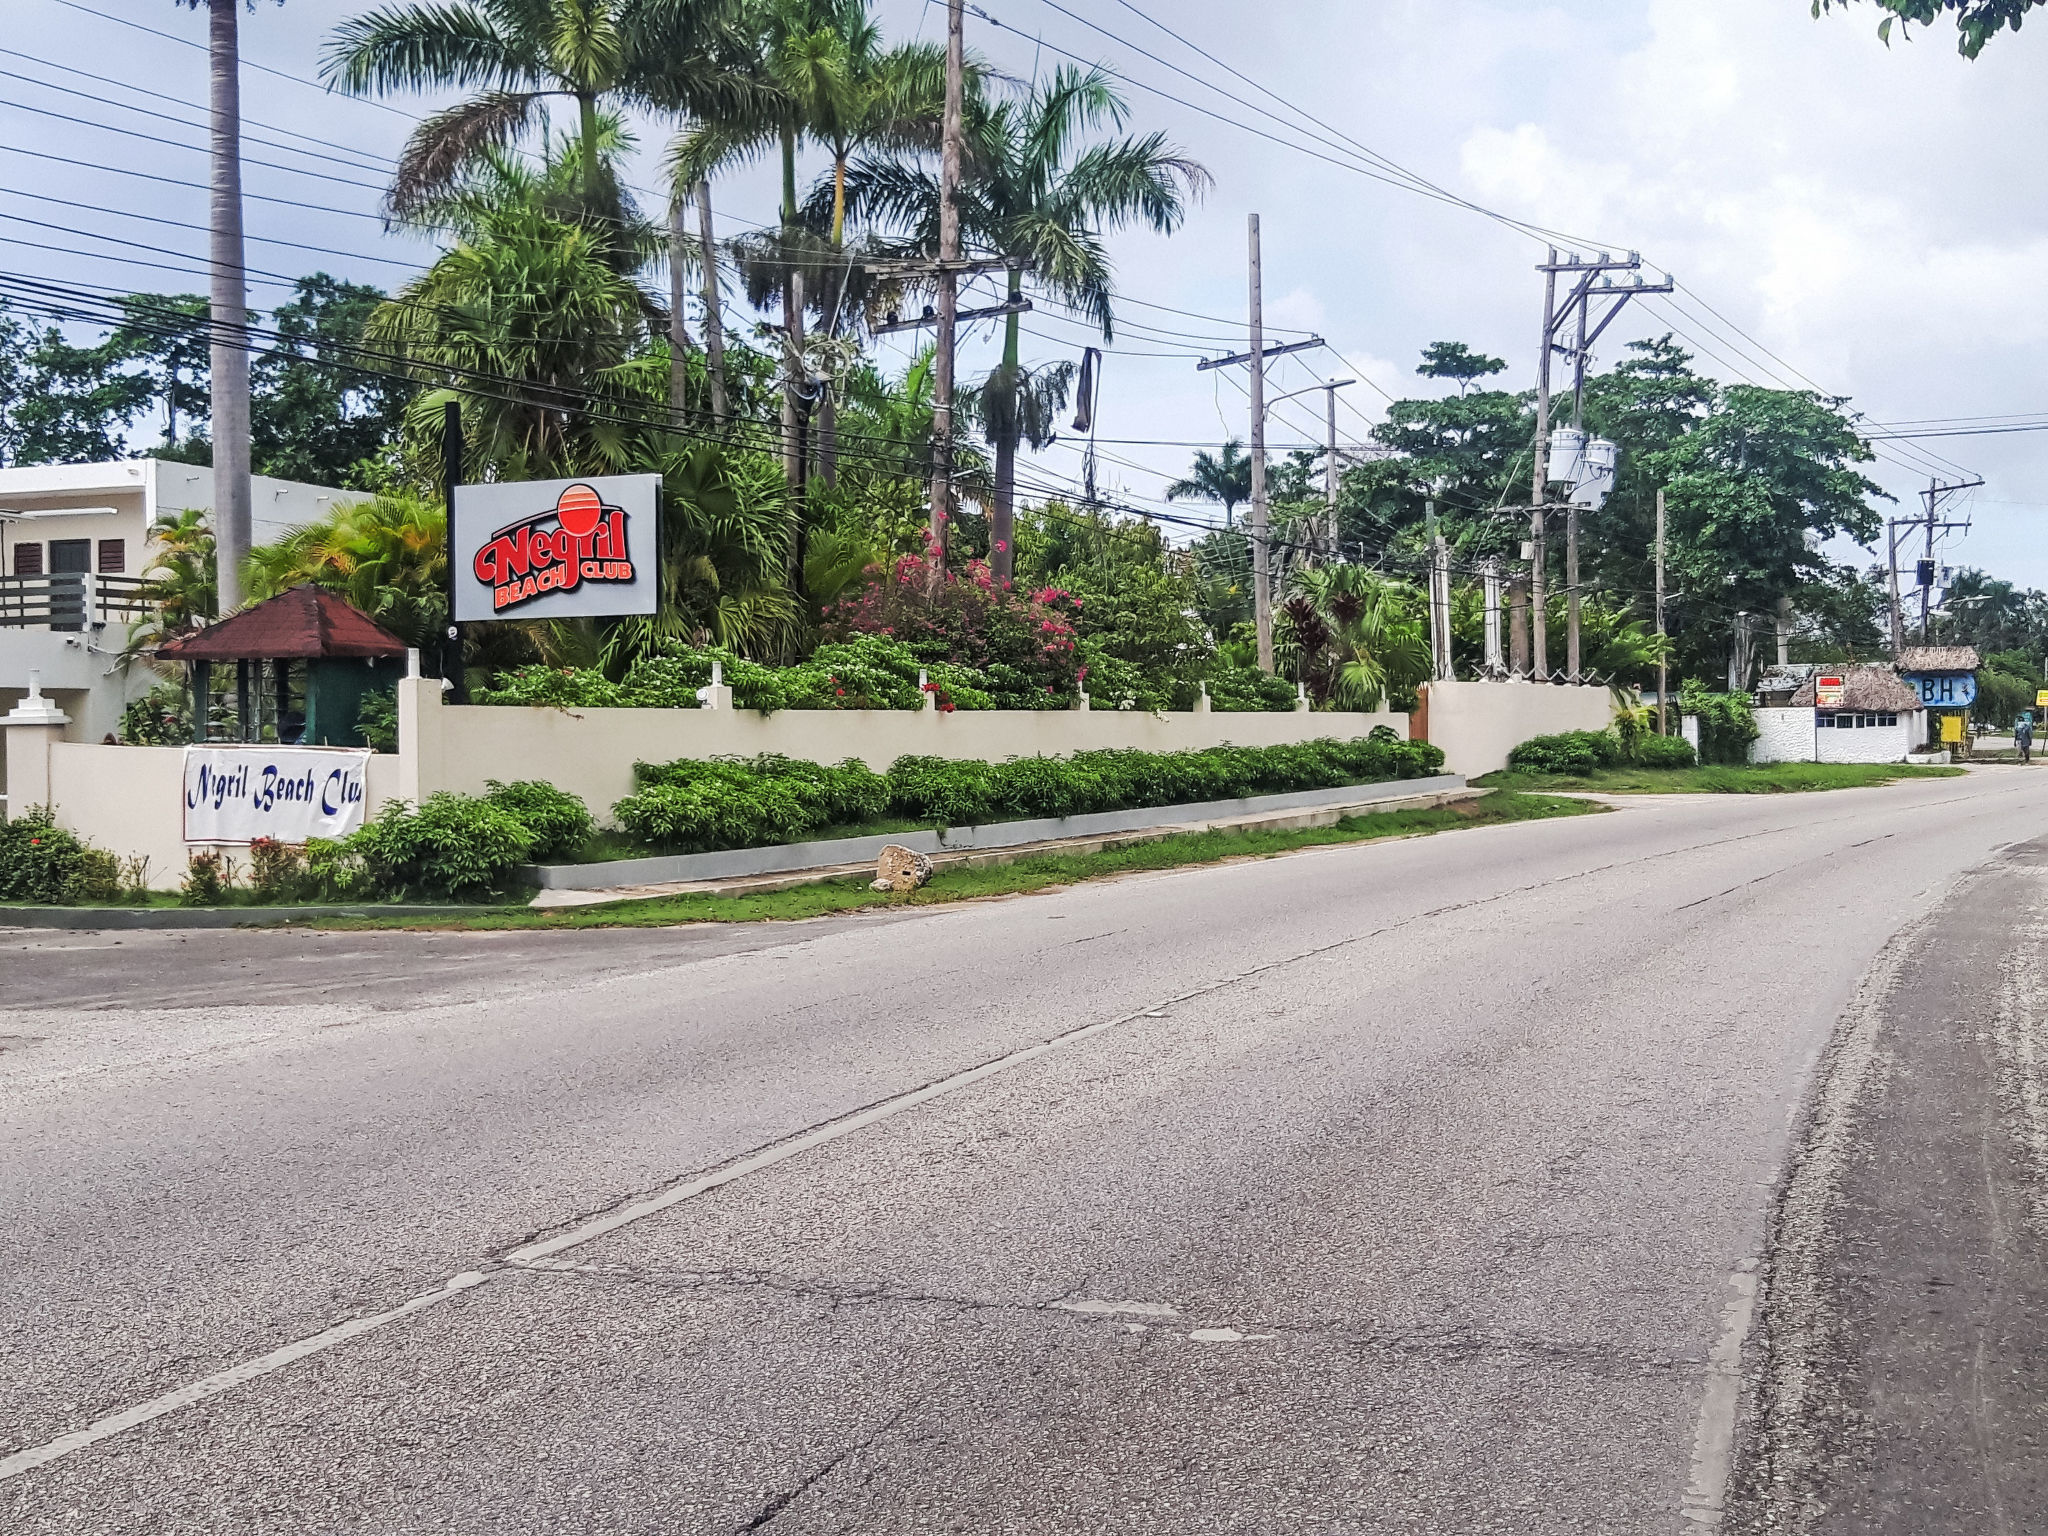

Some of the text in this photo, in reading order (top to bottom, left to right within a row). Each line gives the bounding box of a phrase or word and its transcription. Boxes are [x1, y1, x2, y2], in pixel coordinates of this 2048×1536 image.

[475, 510, 626, 589] Negril
[494, 560, 632, 609] BEACH CLUB
[1922, 679, 1953, 702] BH
[253, 764, 315, 813] Beach
[321, 768, 362, 816] Clu
